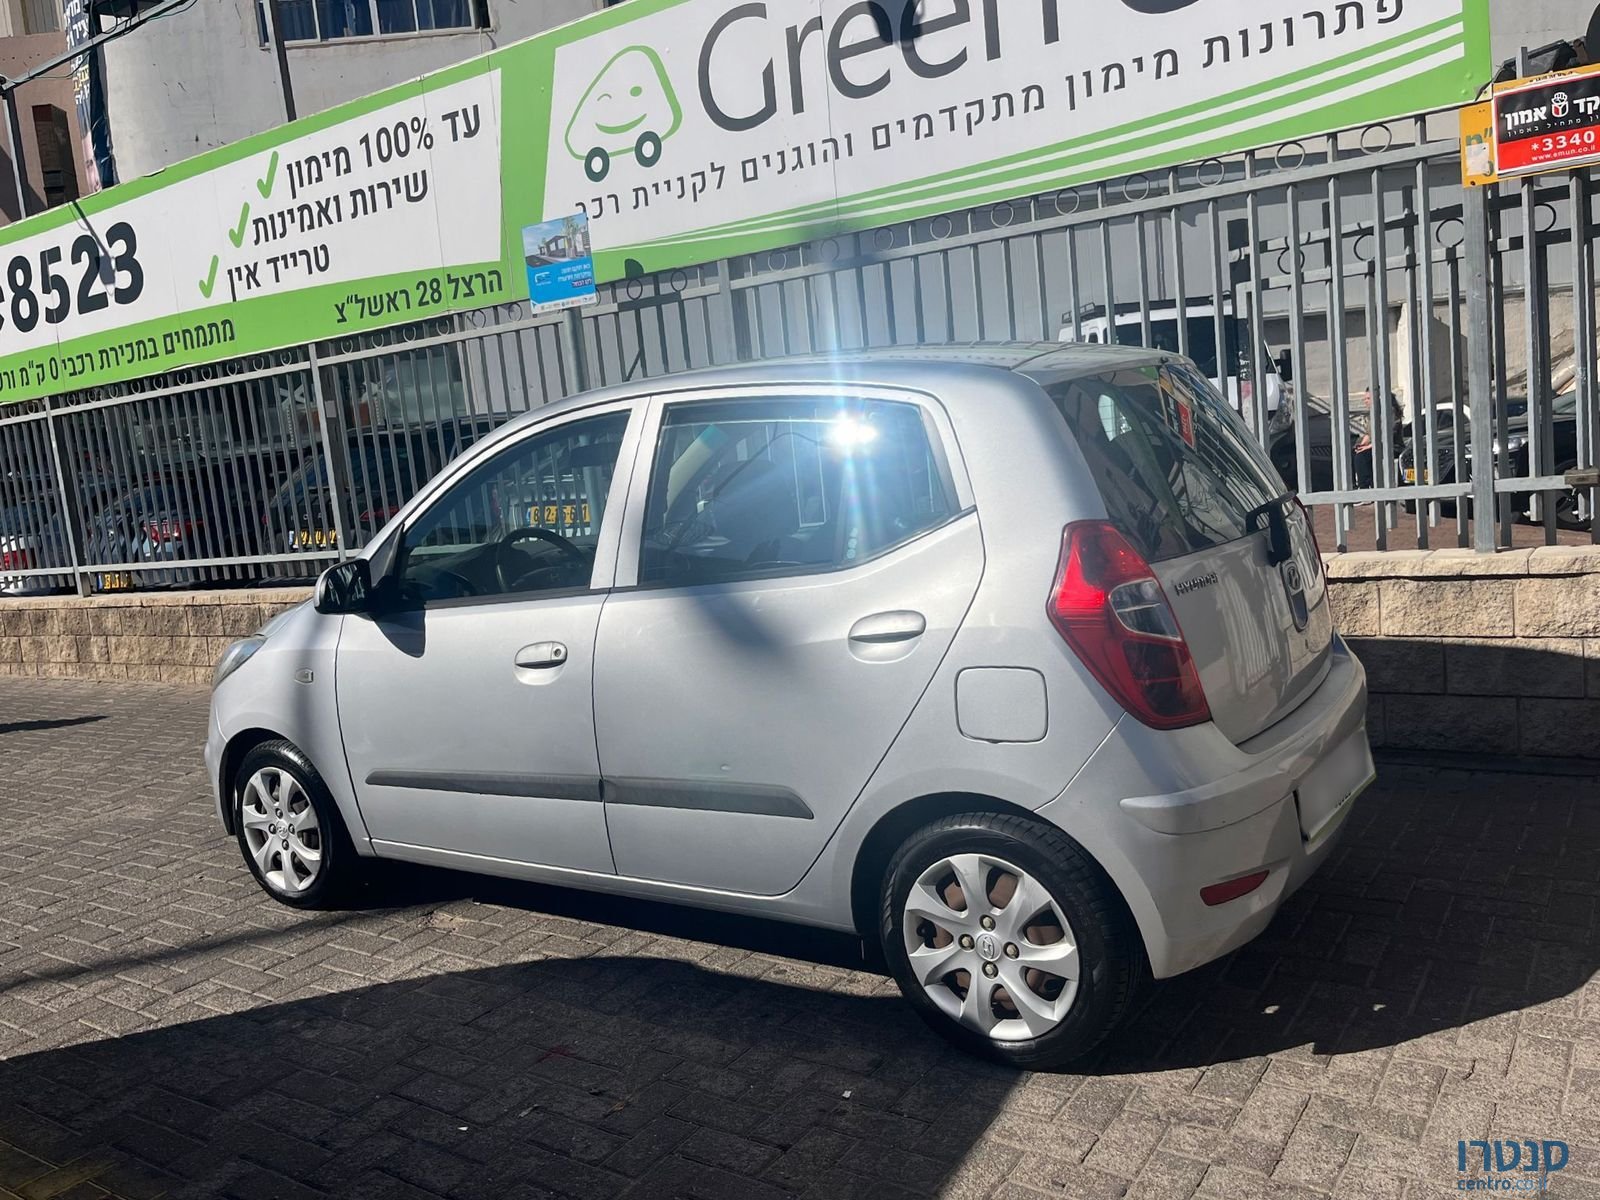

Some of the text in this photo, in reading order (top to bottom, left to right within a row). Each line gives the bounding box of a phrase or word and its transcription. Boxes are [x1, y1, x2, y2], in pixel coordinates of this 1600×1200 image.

[1202, 0, 1403, 68] פתרונות
[1065, 48, 1179, 111] מימון
[872, 84, 1045, 150] מתקדמים
[1505, 106, 1547, 131] אמון
[286, 104, 480, 200] עד 100% מימון
[741, 133, 853, 183] והוגנים
[1531, 145, 1596, 161] www.emun.co.il
[252, 169, 429, 246] שירות ואמינות
[632, 162, 725, 210] לקניית
[0, 221, 144, 333] 8523
[227, 243, 330, 302] טרייד אין
[415, 277, 442, 307] 28
[447, 269, 503, 300] הרצל
[99, 337, 159, 371] במכירת
[163, 318, 235, 355] מתמחים
[49, 357, 58, 380] 0
[61, 352, 95, 377] רכבי
